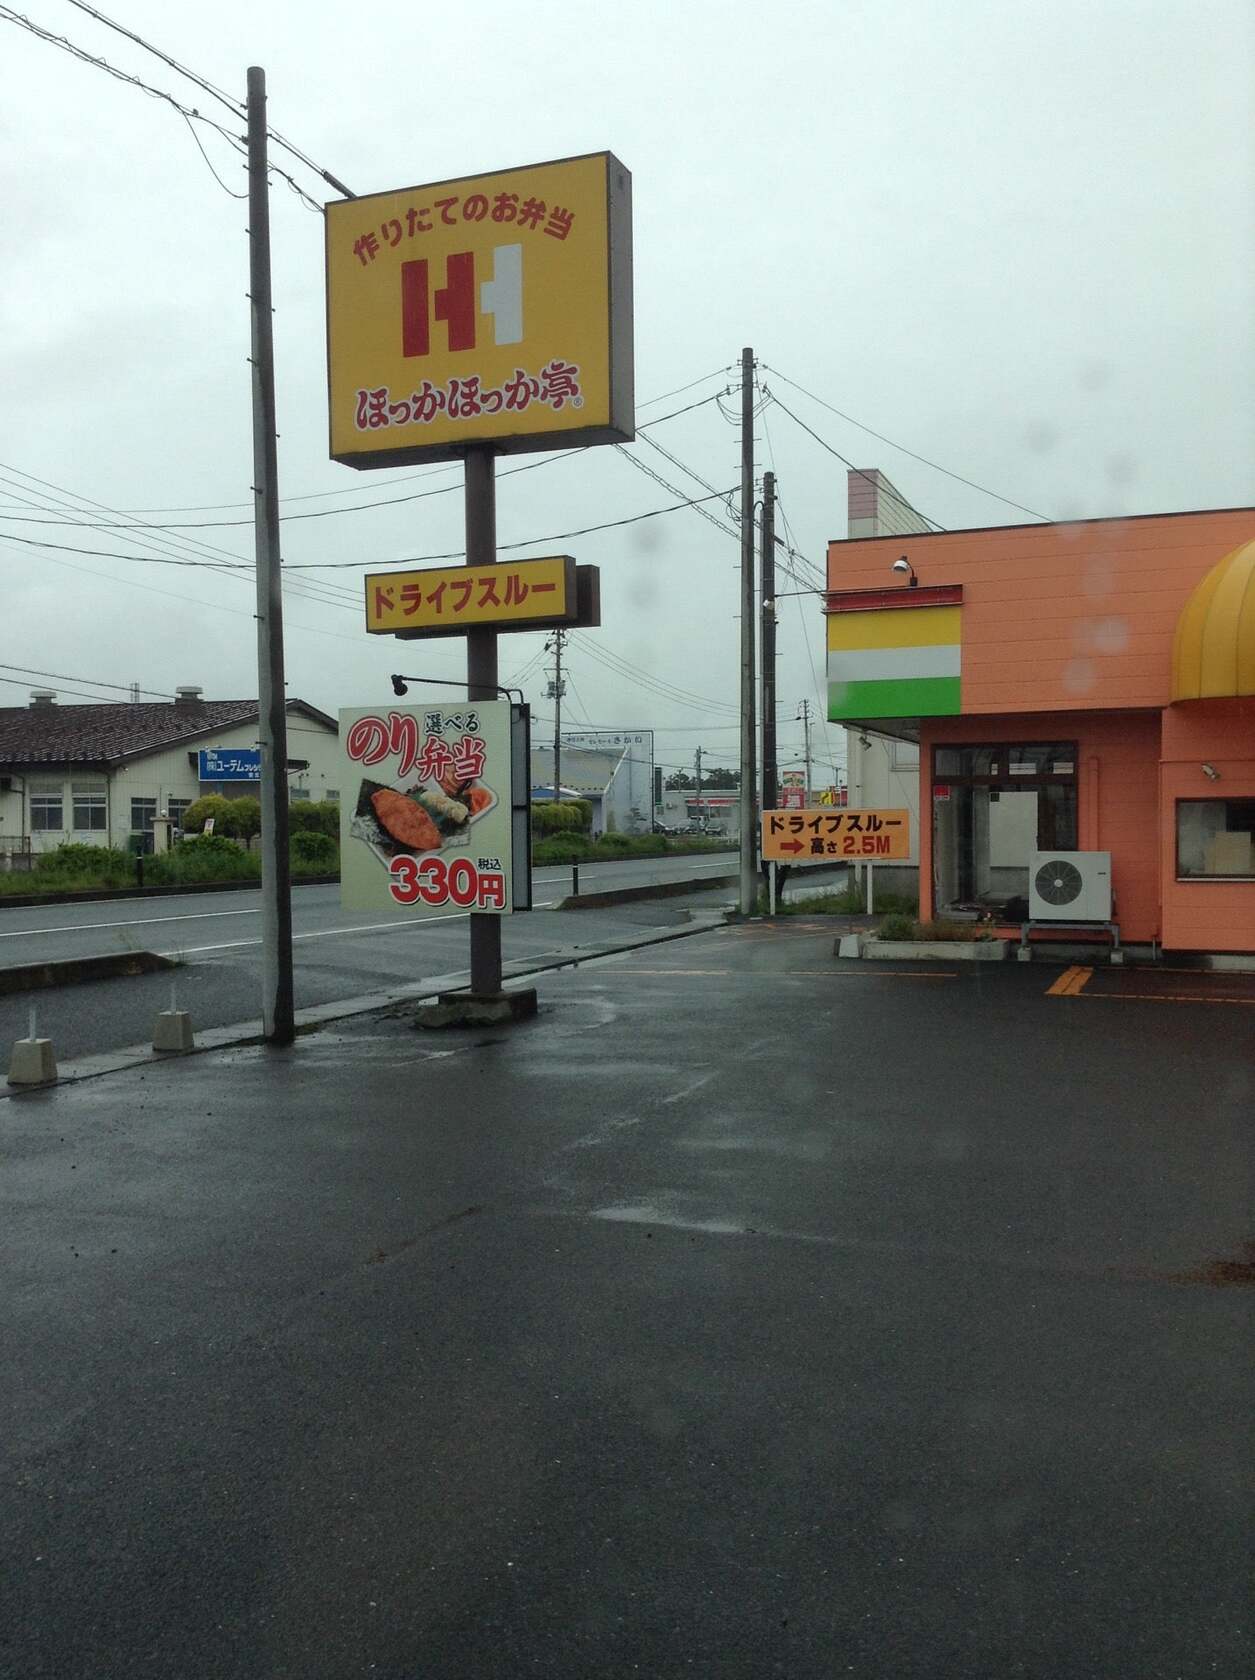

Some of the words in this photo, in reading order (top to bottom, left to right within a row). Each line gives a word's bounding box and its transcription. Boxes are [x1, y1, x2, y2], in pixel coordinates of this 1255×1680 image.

[353, 191, 576, 267] 作りたてのお弁当
[355, 361, 581, 431] ほっかほっか亭
[374, 574, 556, 620] ドライブスルー
[424, 712, 480, 736] 選べる
[347, 711, 487, 783] のり弁当
[769, 814, 903, 835] ドライブスルー
[810, 836, 838, 856] 高さ
[842, 835, 891, 855] 2.5M
[477, 857, 502, 871] 税込
